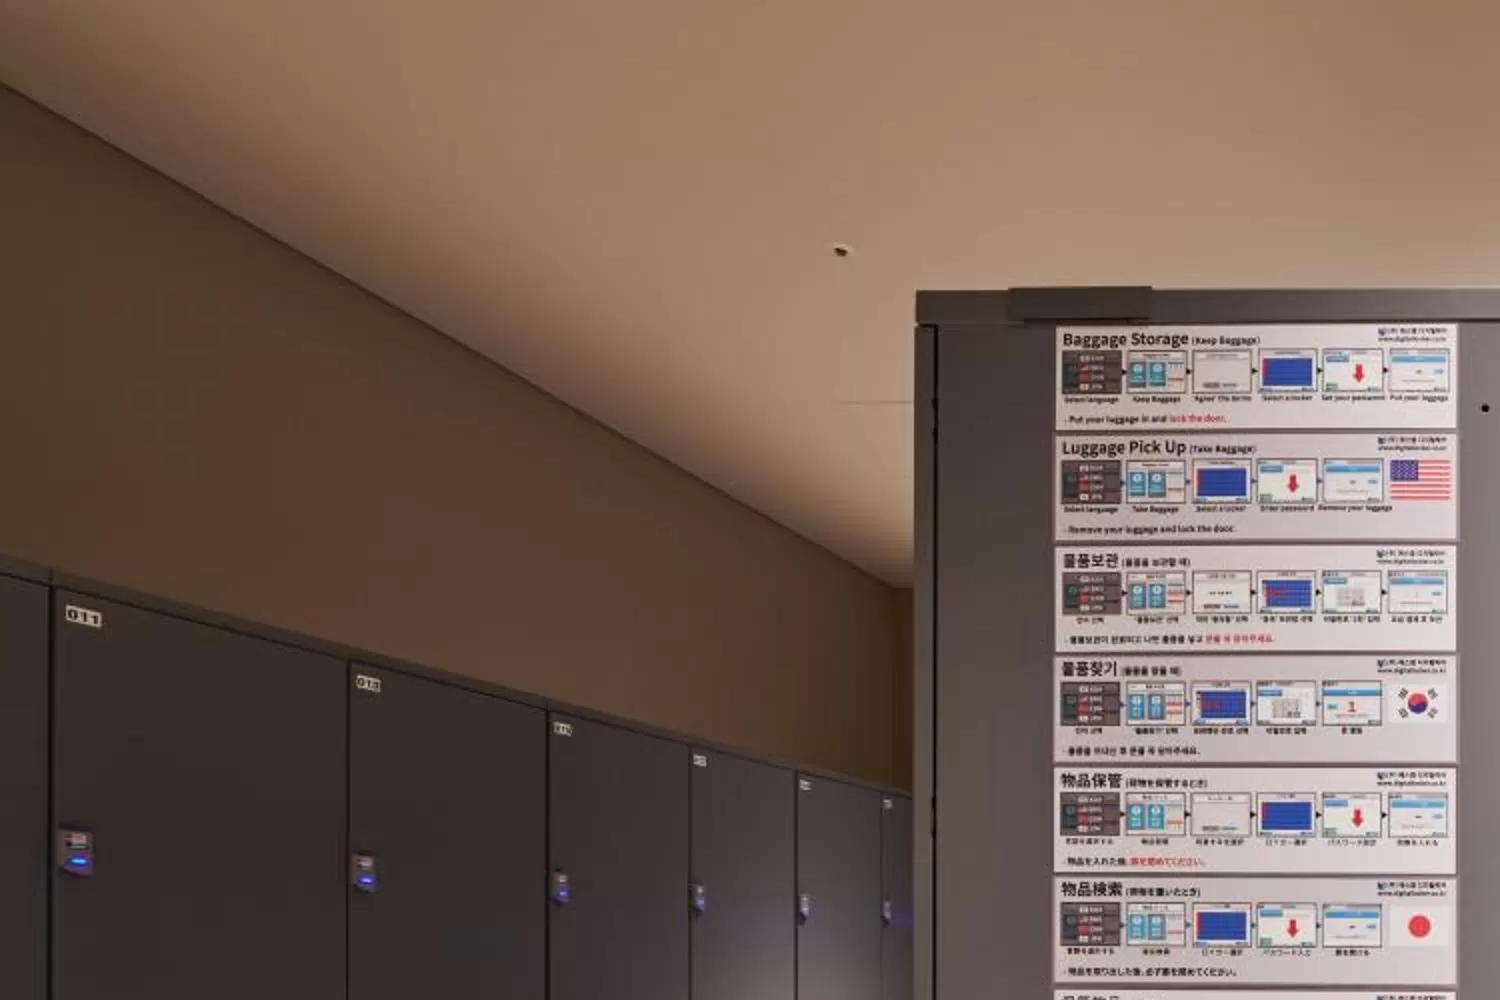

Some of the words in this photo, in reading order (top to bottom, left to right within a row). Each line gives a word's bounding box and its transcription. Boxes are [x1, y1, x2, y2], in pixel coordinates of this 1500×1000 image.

[1063, 333, 1126, 348] Baggage
[1131, 333, 1188, 348] Storage
[1191, 337, 1217, 346] (Keep
[1219, 336, 1260, 346] Baggage)
[1106, 415, 1139, 424] luggage
[1152, 415, 1167, 423] and
[1188, 414, 1202, 422] the
[1063, 441, 1124, 458] Luggage
[1130, 440, 1160, 454] Pick
[1166, 441, 1187, 458] Up
[1190, 445, 1213, 454] (Take
[1215, 445, 1256, 455] Baggage)
[1150, 506, 1178, 514] Baggage
[1104, 527, 1124, 535] your
[1126, 525, 1159, 535] luggage
[1161, 525, 1177, 533] and
[1178, 525, 1196, 533] lock
[1197, 525, 1212, 533] the
[1064, 553, 1118, 568] 물품보관
[67, 607, 100, 626] 011
[1063, 662, 1117, 677] 물품찾기
[1061, 774, 1122, 788] 物品保管
[1061, 882, 1122, 897] 物品検索
